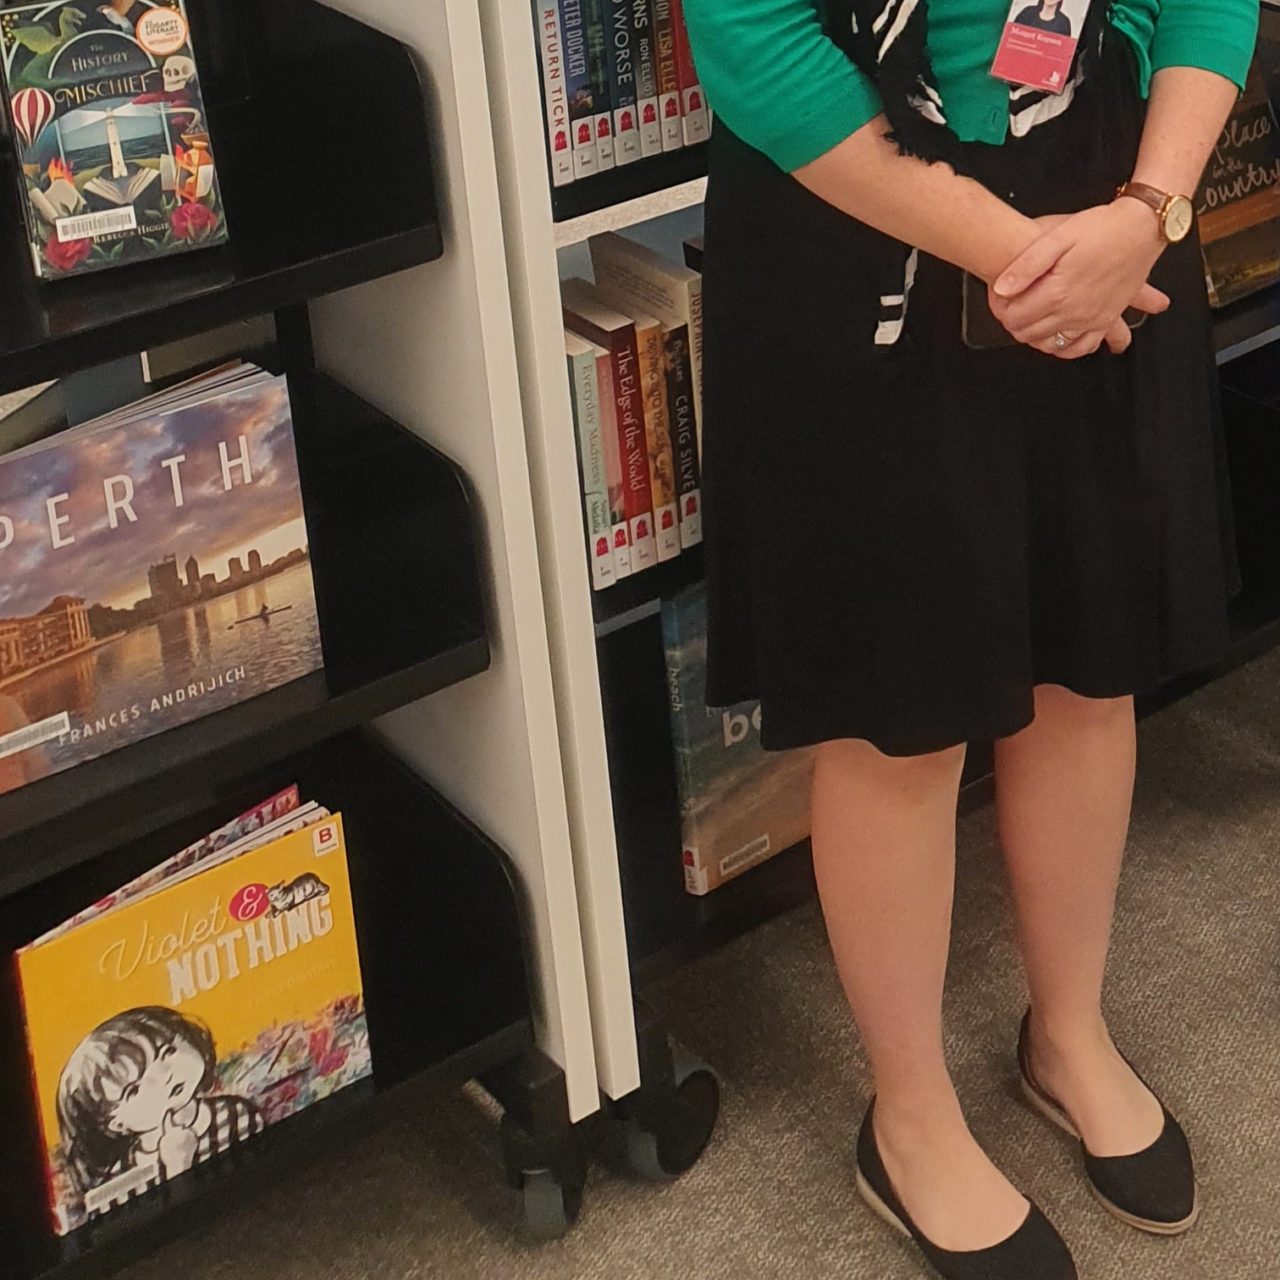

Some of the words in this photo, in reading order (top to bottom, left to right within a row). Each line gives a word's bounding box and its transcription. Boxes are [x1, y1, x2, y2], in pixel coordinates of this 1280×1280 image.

[71, 51, 129, 73] HISTORY
[543, 9, 560, 81] RETURN
[566, 29, 586, 78] DOCKER
[612, 6, 633, 87] WORSE
[639, 38, 649, 60] RON
[657, 28, 672, 58] LISA
[54, 69, 160, 109] MISCHIEF
[551, 87, 566, 127] TICK
[617, 344, 631, 372] The
[582, 364, 595, 424] Everyday
[617, 374, 639, 412] Edge
[624, 411, 637, 429] of
[624, 425, 640, 452] the
[675, 394, 692, 446] CRAIG
[587, 426, 602, 487] Madness
[626, 450, 645, 492] World
[680, 447, 697, 491] SILVE
[57, 705, 141, 746] FRANCES
[149, 665, 247, 714] ANDRIJICH
[669, 668, 683, 712] beach
[319, 827, 333, 844] B
[100, 894, 229, 982] Violet
[237, 886, 263, 920] &
[164, 895, 334, 1007] NOTHING
